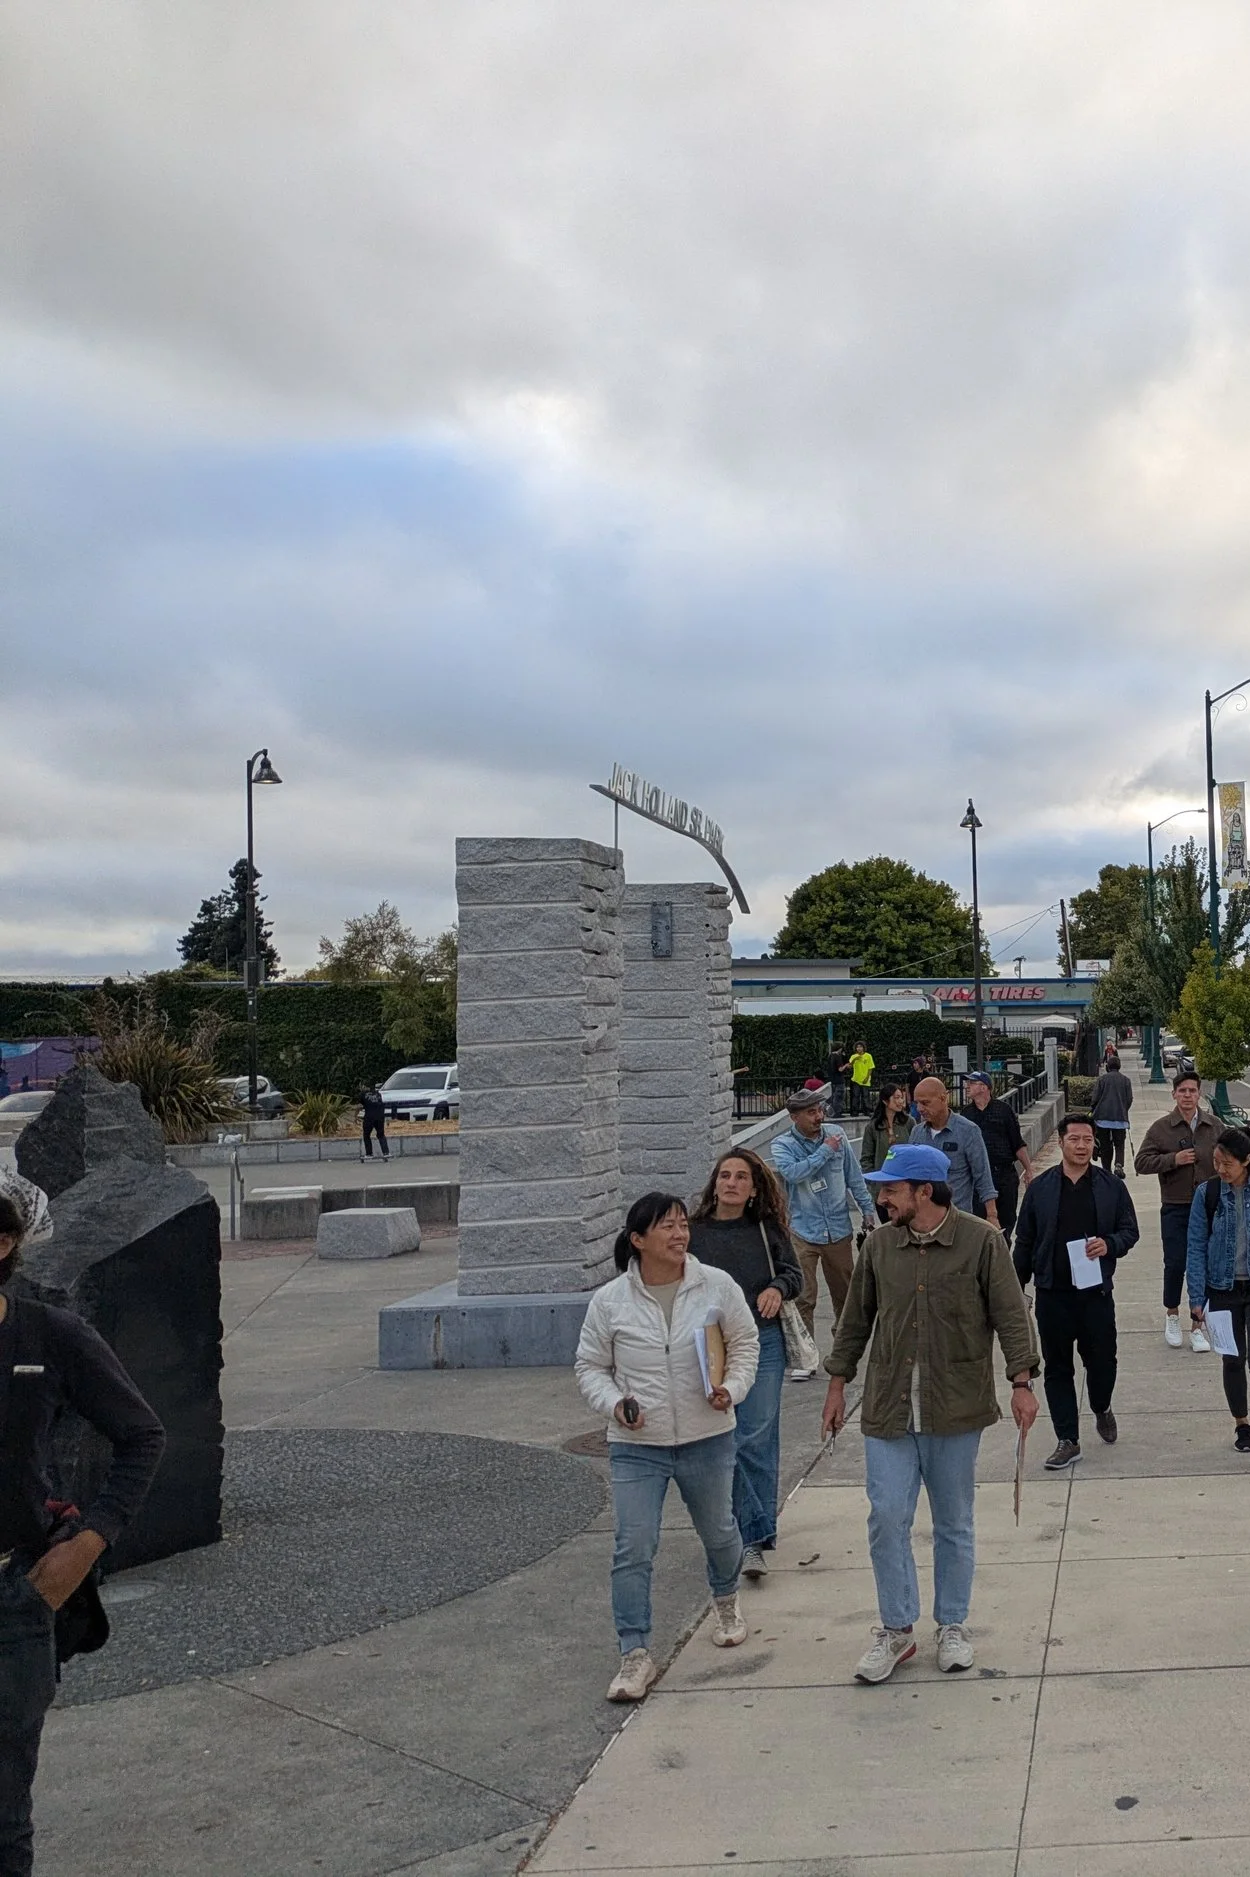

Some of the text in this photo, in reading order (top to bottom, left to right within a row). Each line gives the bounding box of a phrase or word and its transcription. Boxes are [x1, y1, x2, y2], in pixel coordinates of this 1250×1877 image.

[608, 761, 641, 807] JACK
[641, 780, 689, 830] HOLLAND
[990, 986, 1046, 1001] TIRES
